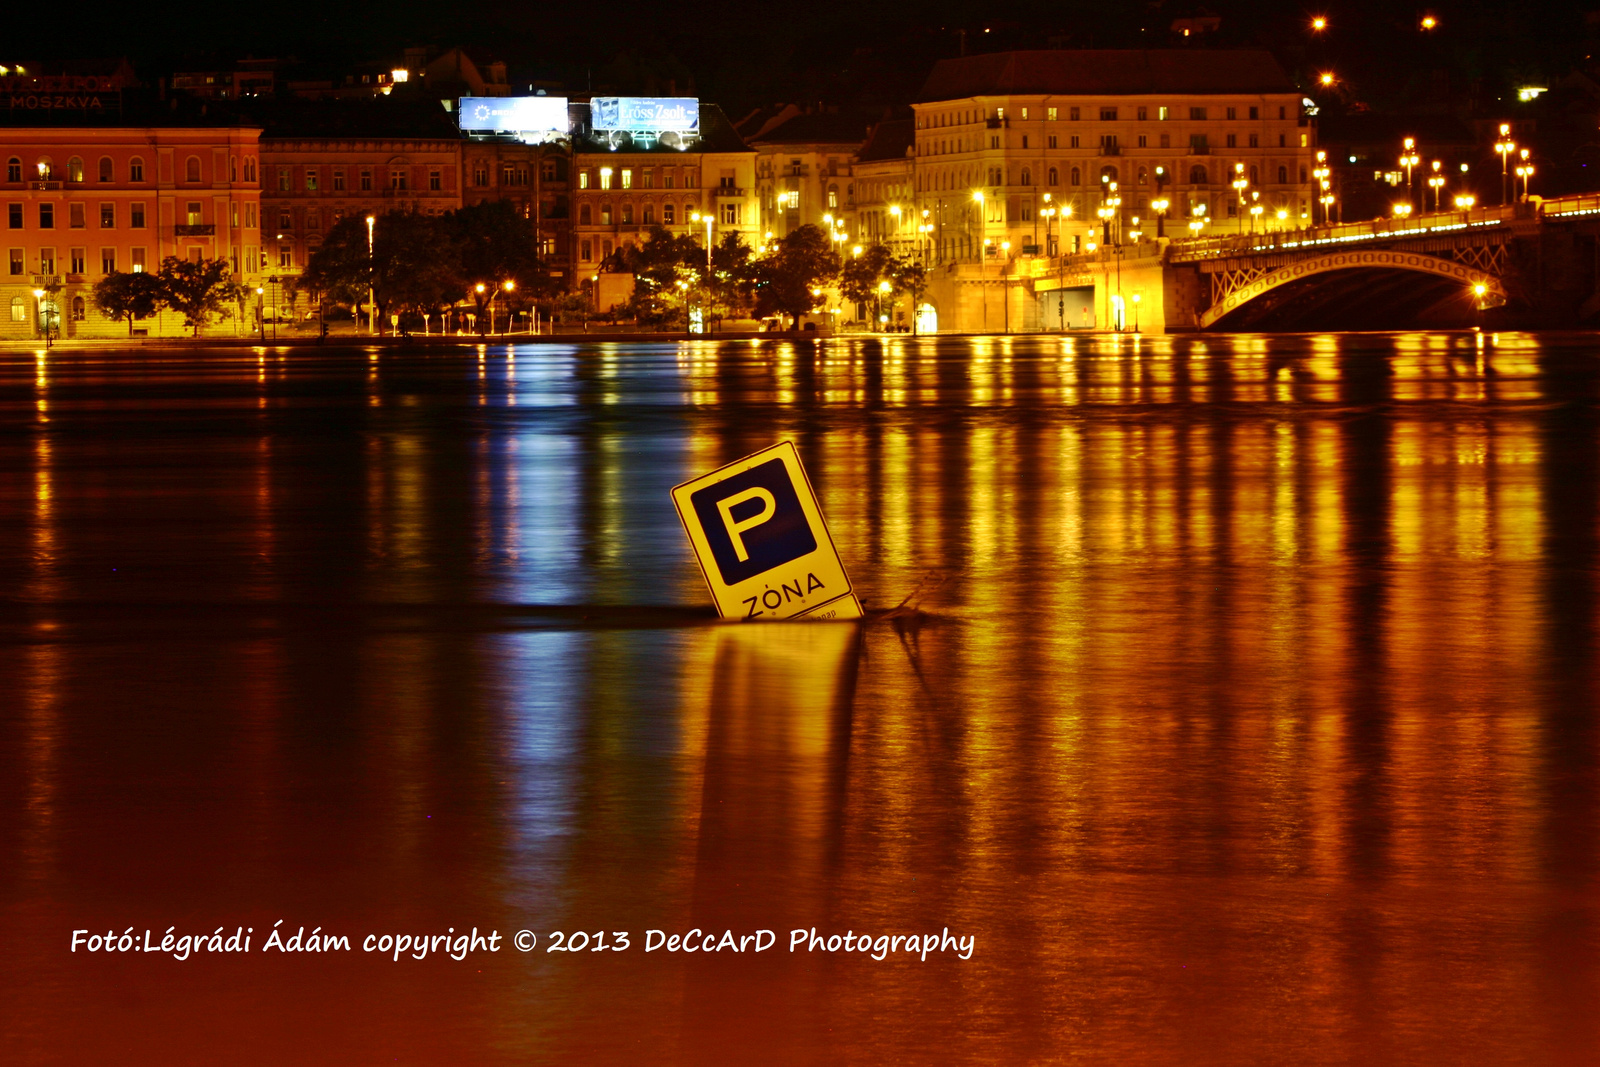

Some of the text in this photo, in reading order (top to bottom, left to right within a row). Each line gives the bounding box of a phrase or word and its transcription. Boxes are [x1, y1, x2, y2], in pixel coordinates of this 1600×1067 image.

[11, 96, 102, 109] MOSZKVA
[716, 486, 776, 563] P
[742, 572, 825, 619] ZÓNA
